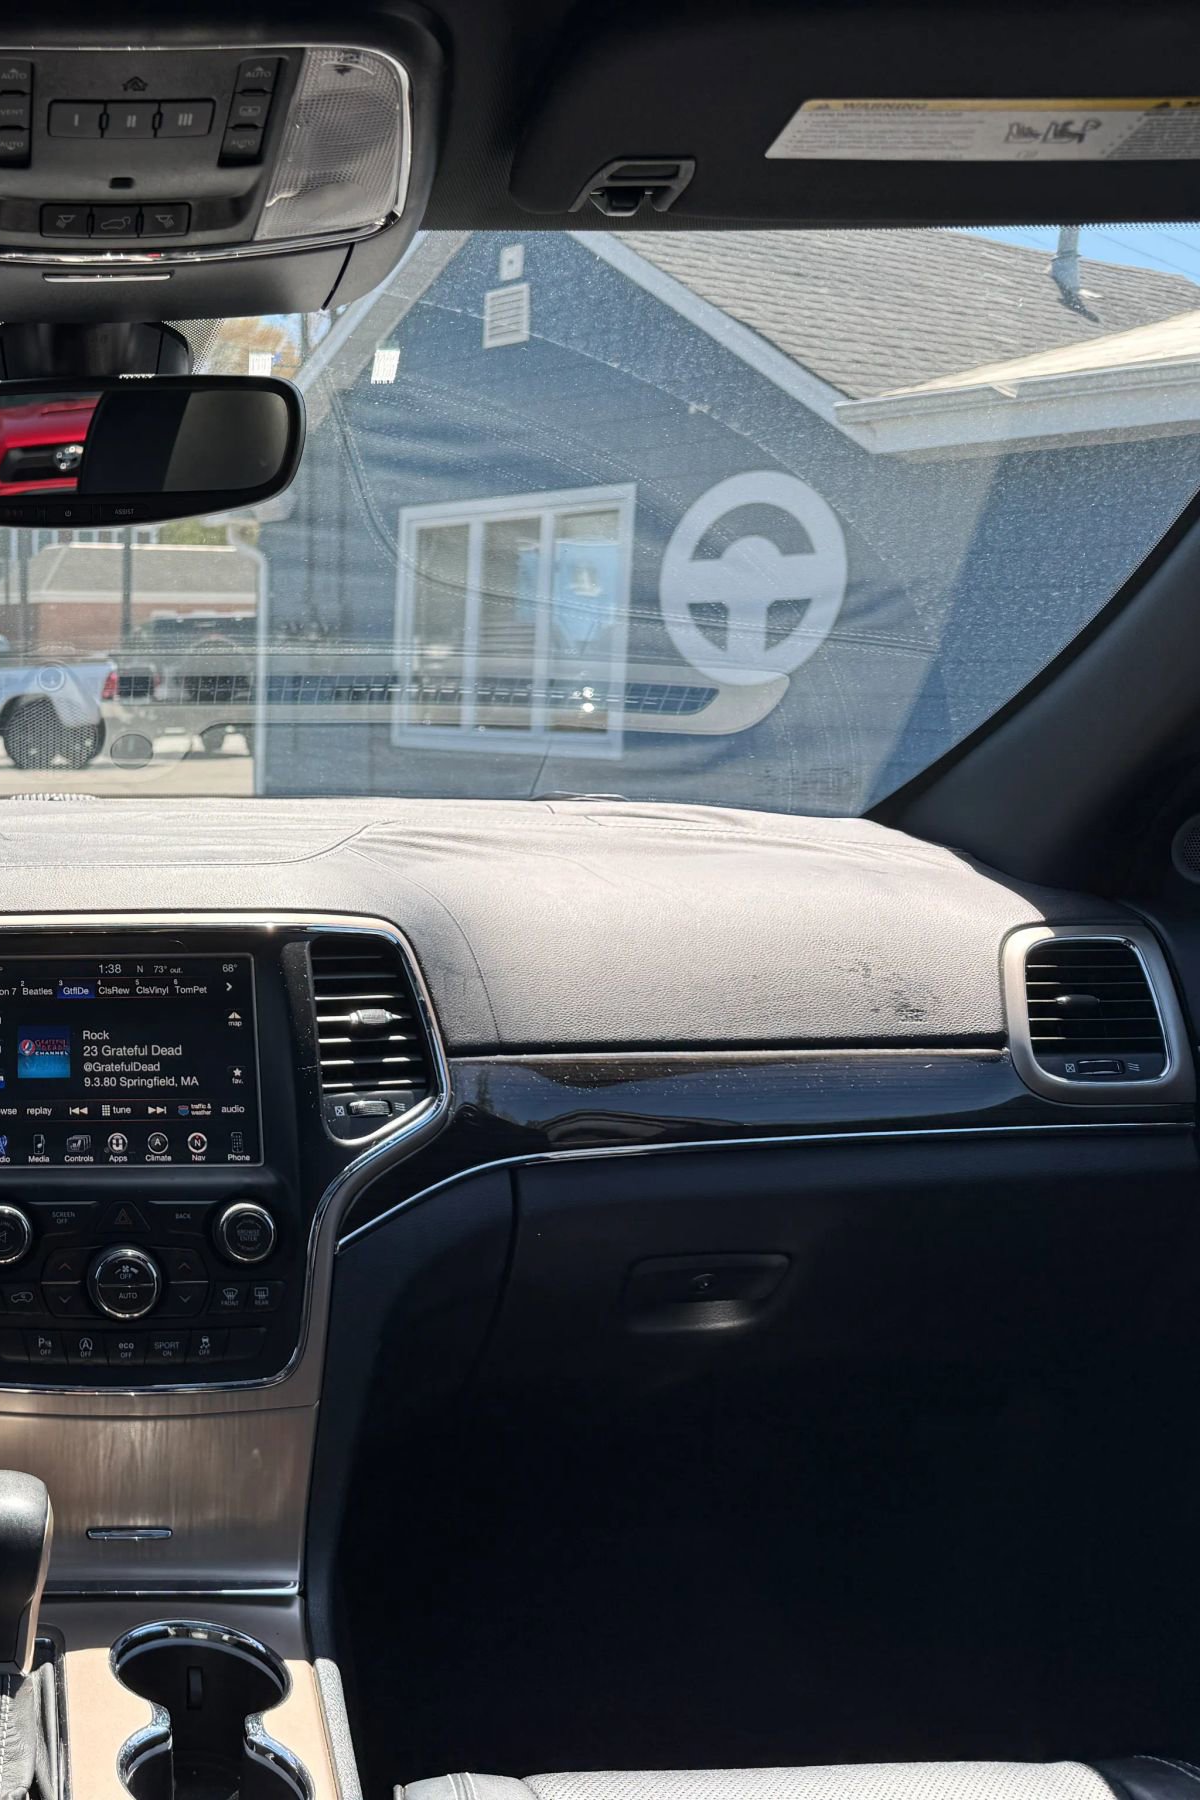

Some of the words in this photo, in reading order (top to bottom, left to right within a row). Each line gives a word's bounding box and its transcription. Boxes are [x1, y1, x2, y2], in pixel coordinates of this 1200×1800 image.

[1, 71, 27, 80] AUTO
[245, 70, 271, 79] AUTO
[0, 108, 24, 116] VENT
[98, 964, 122, 974] 1:38
[136, 965, 144, 973] N
[153, 965, 167, 973] 73°
[11, 987, 17, 996] 7
[22, 987, 53, 996] Beatles
[175, 985, 208, 994] TomPet
[82, 1030, 110, 1040] Rock
[83, 1045, 98, 1057] 23
[101, 1044, 148, 1056] Grateful
[151, 1044, 183, 1056] Dead
[83, 1061, 161, 1072] @GratefulDead
[84, 1076, 117, 1087] 9.3.80
[119, 1076, 178, 1088] Springfield,
[180, 1076, 199, 1086] MA
[26, 1106, 52, 1116] replay
[112, 1106, 132, 1114] tune
[221, 1105, 245, 1113] audio
[28, 1155, 50, 1163] Media
[109, 1155, 128, 1163] Apps
[145, 1154, 172, 1162] Climate
[227, 1153, 251, 1161] Phone
[118, 1342, 134, 1350] eco
[154, 1342, 180, 1350] SPORT
